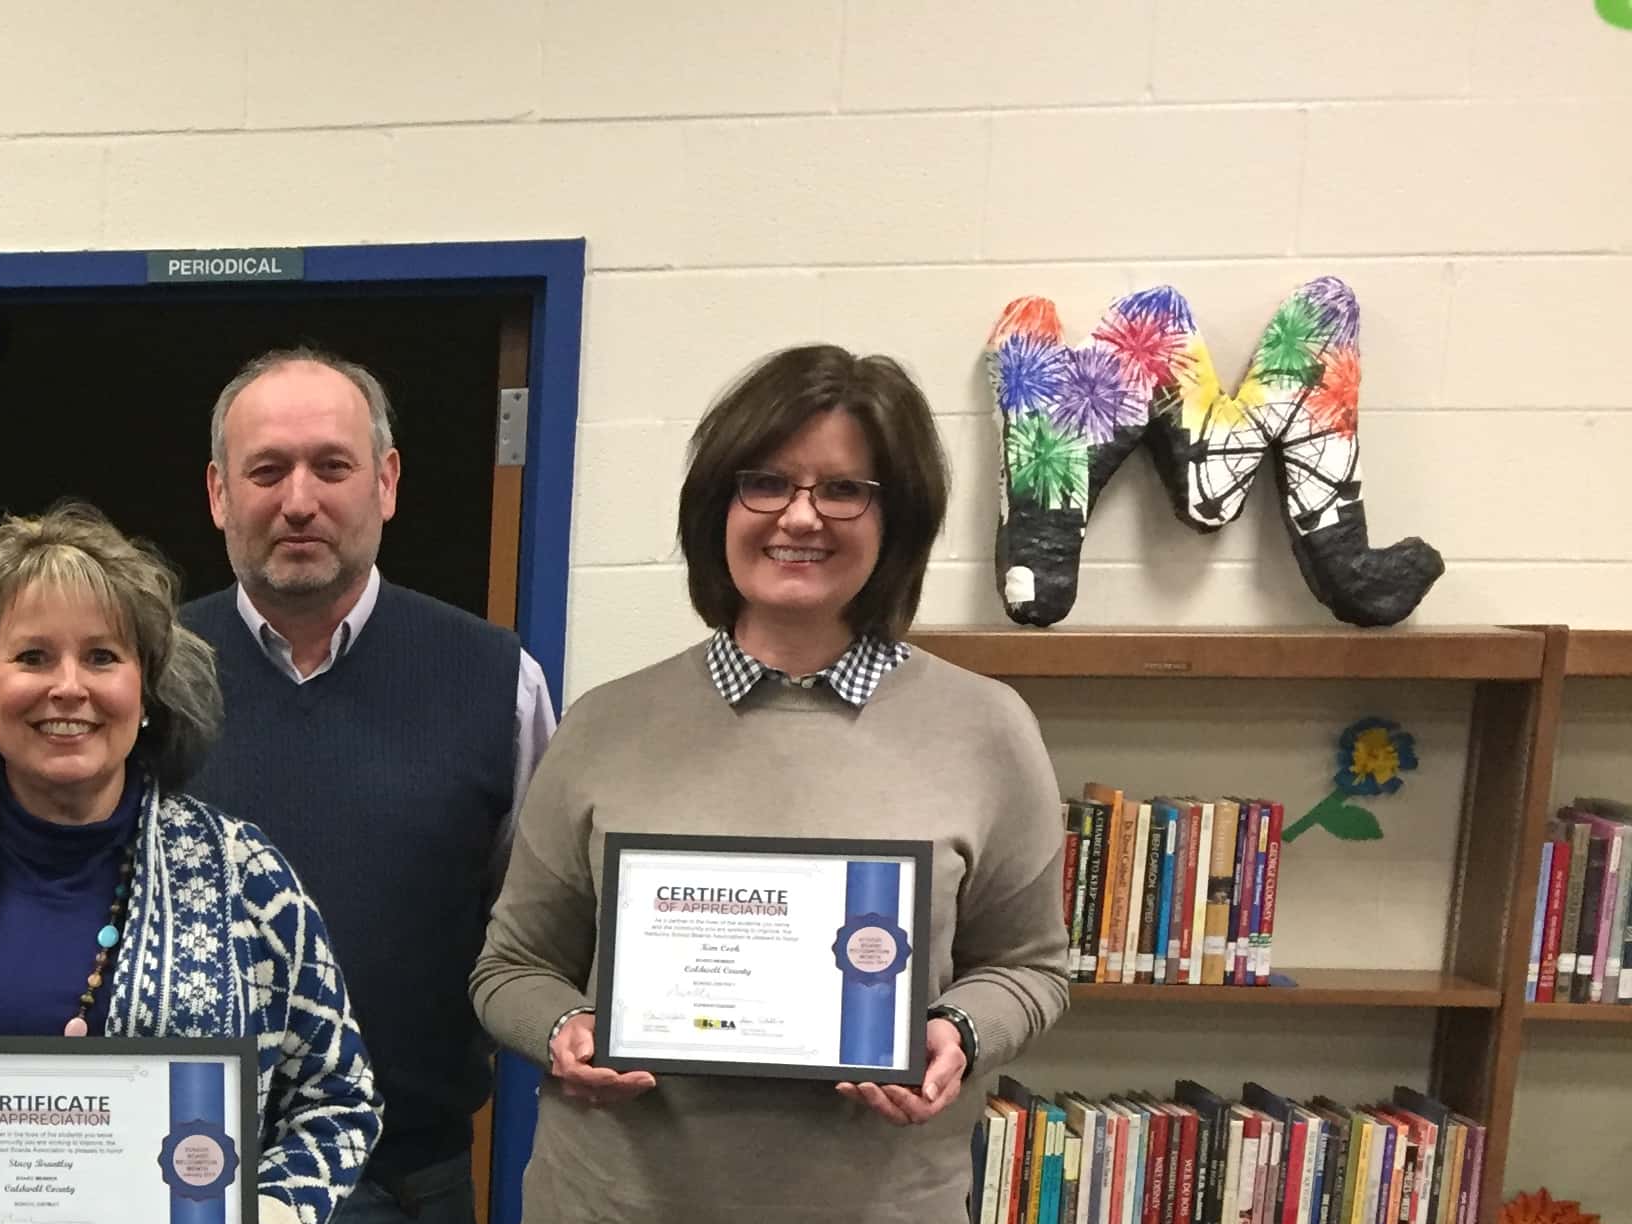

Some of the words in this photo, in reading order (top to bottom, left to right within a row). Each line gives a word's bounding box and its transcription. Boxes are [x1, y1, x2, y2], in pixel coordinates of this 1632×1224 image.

[168, 257, 282, 276] PERIODICAL
[657, 886, 788, 905] CERTIFICATE
[658, 901, 678, 913] OF
[682, 902, 788, 917] APPRECIATION
